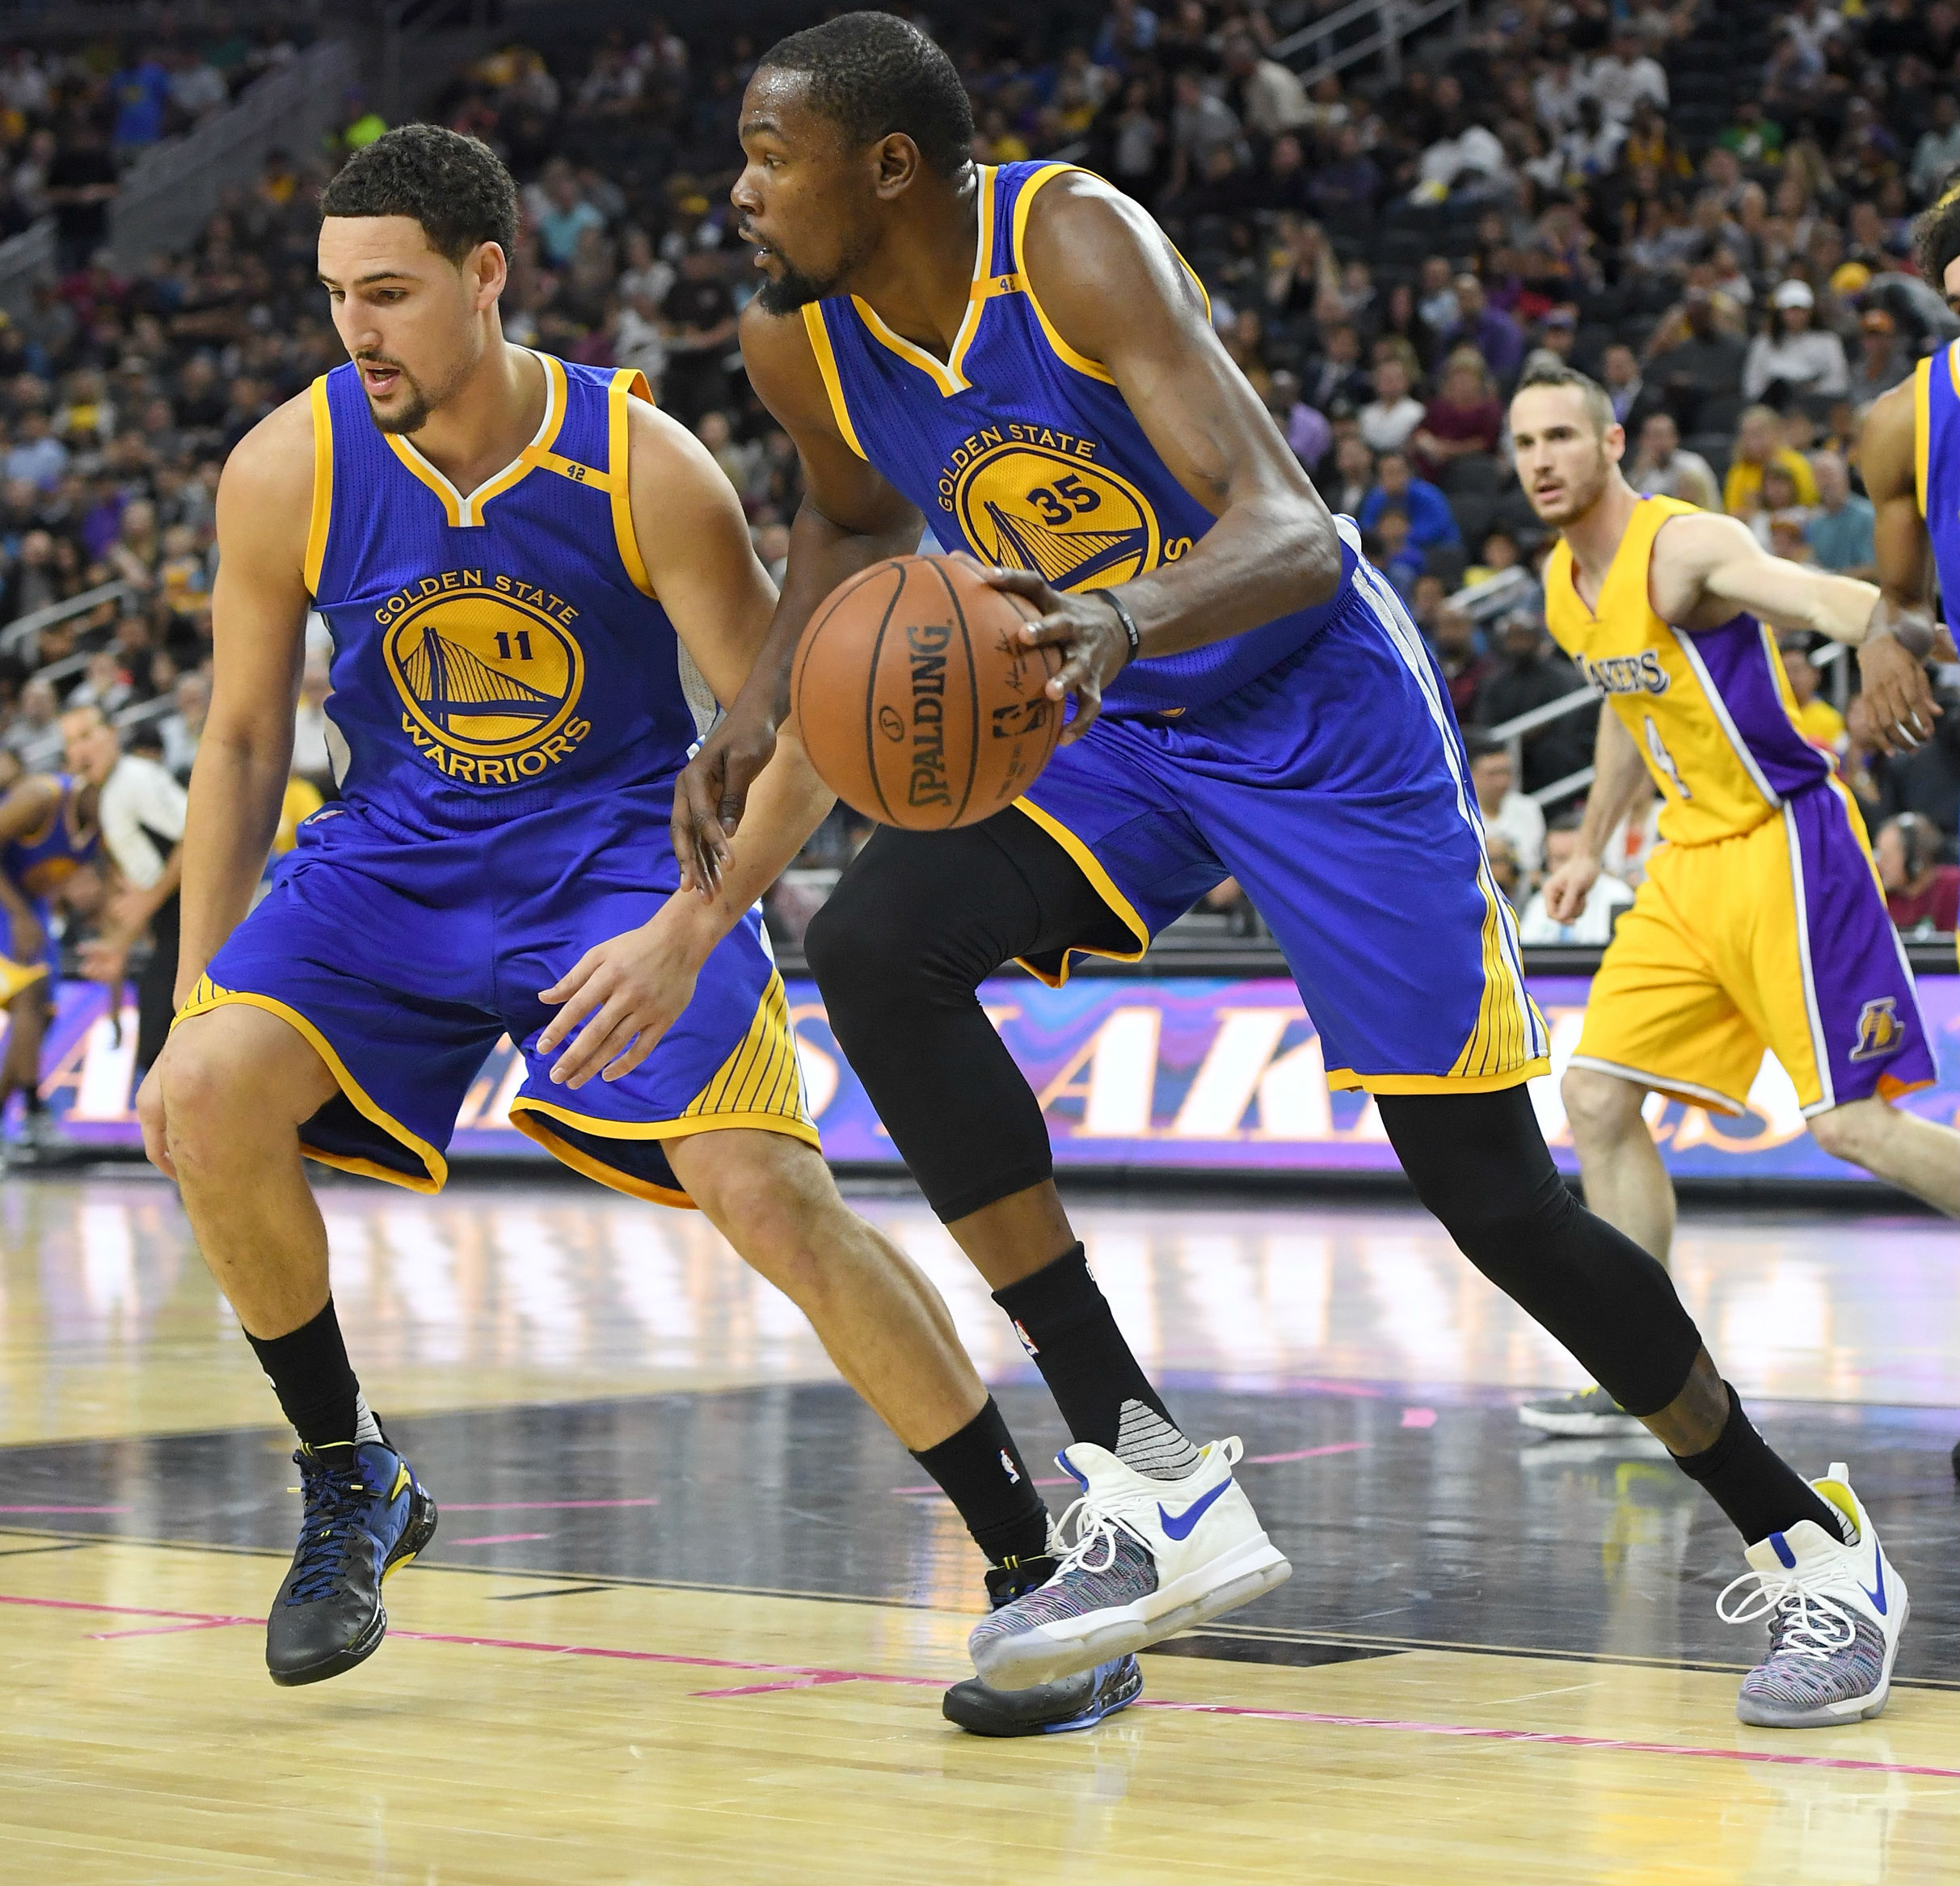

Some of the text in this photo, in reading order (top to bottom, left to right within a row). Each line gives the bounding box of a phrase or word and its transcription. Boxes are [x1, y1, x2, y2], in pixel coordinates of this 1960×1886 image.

[567, 465, 586, 481] 42
[938, 424, 1096, 513] GOLDEN STATE
[1026, 473, 1102, 525] 35
[375, 569, 580, 625] GOLDEN STATE
[493, 631, 533, 660] 11
[402, 711, 592, 784] WARRIORS
[907, 625, 952, 807] SPALDING
[1644, 714, 1692, 800] 4
